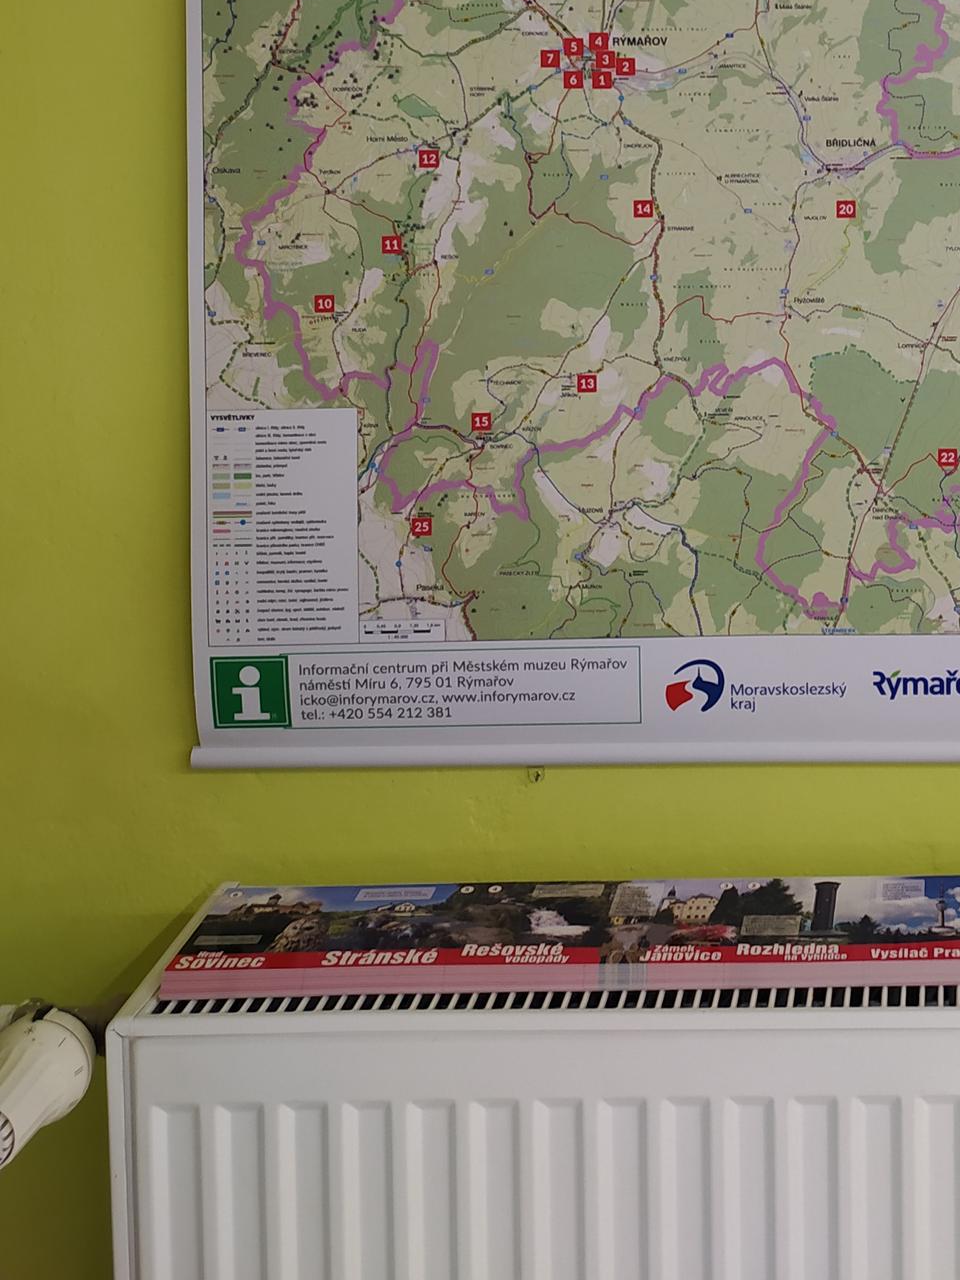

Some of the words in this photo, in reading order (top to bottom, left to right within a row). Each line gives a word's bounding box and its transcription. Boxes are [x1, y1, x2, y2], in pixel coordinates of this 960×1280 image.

[612, 35, 668, 46] RÝMAŘOV
[826, 136, 876, 148] BŘIDLIČNÁ
[299, 663, 368, 675] Informační
[373, 664, 427, 674] centrum
[432, 661, 448, 675] při
[453, 660, 519, 672] Městském
[524, 662, 565, 670] muzeu
[571, 659, 627, 672] Rýmařov
[300, 679, 350, 690] náměstí
[356, 679, 385, 689] Míru
[390, 678, 401, 689] 6,
[406, 677, 431, 688] 795
[436, 677, 451, 688] 01
[458, 676, 513, 689] Rýmařov
[730, 681, 847, 698] Moravskoslezský
[300, 694, 438, 706] icko@inforymarov.cz,
[442, 691, 575, 703] www.inforymarov.cz
[730, 697, 756, 713] kraj
[301, 709, 324, 720] tel.:
[329, 708, 363, 719] +420
[368, 708, 392, 719] 554
[398, 707, 422, 718] 212
[427, 707, 451, 718] 381
[461, 943, 564, 957] Rešovské
[654, 944, 695, 952] Zámek
[736, 943, 839, 955] Rozhledna
[871, 948, 929, 959] Vysílač
[175, 955, 266, 969] Sovinec
[321, 948, 438, 966] Stránské
[639, 950, 721, 962] Janovice
